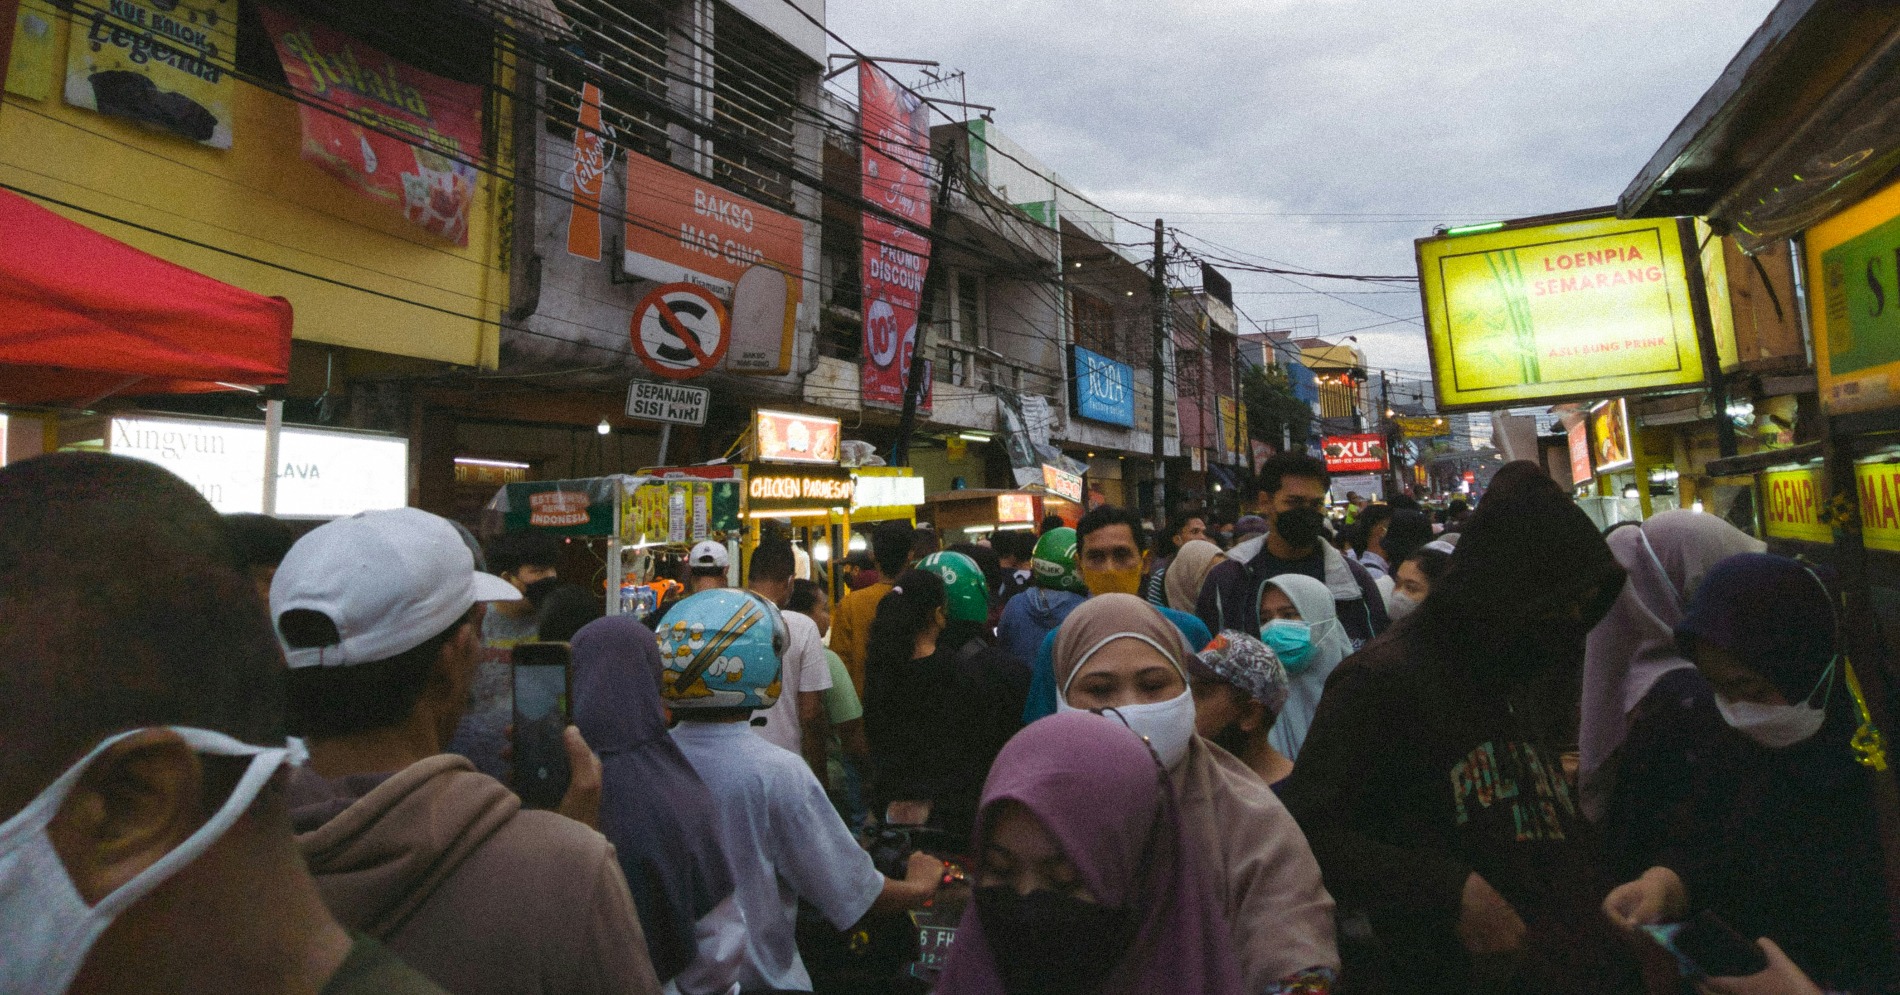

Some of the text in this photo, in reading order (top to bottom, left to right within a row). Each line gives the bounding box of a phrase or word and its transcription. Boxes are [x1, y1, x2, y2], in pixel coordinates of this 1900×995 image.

[88, 11, 221, 84] Legenda
[694, 188, 754, 233] BAKSO
[680, 222, 719, 260] MAS
[879, 239, 920, 272] PROMO
[1544, 245, 1643, 272] LOENPIA
[1534, 266, 1663, 297] SEMARANG
[1088, 356, 1124, 403] ROPA
[636, 384, 702, 405] SEPANJANG
[633, 401, 699, 421] SISI KIRI
[277, 461, 320, 480] AVA
[751, 477, 800, 497] CHICKEN
[531, 513, 589, 524] INDONESIA
